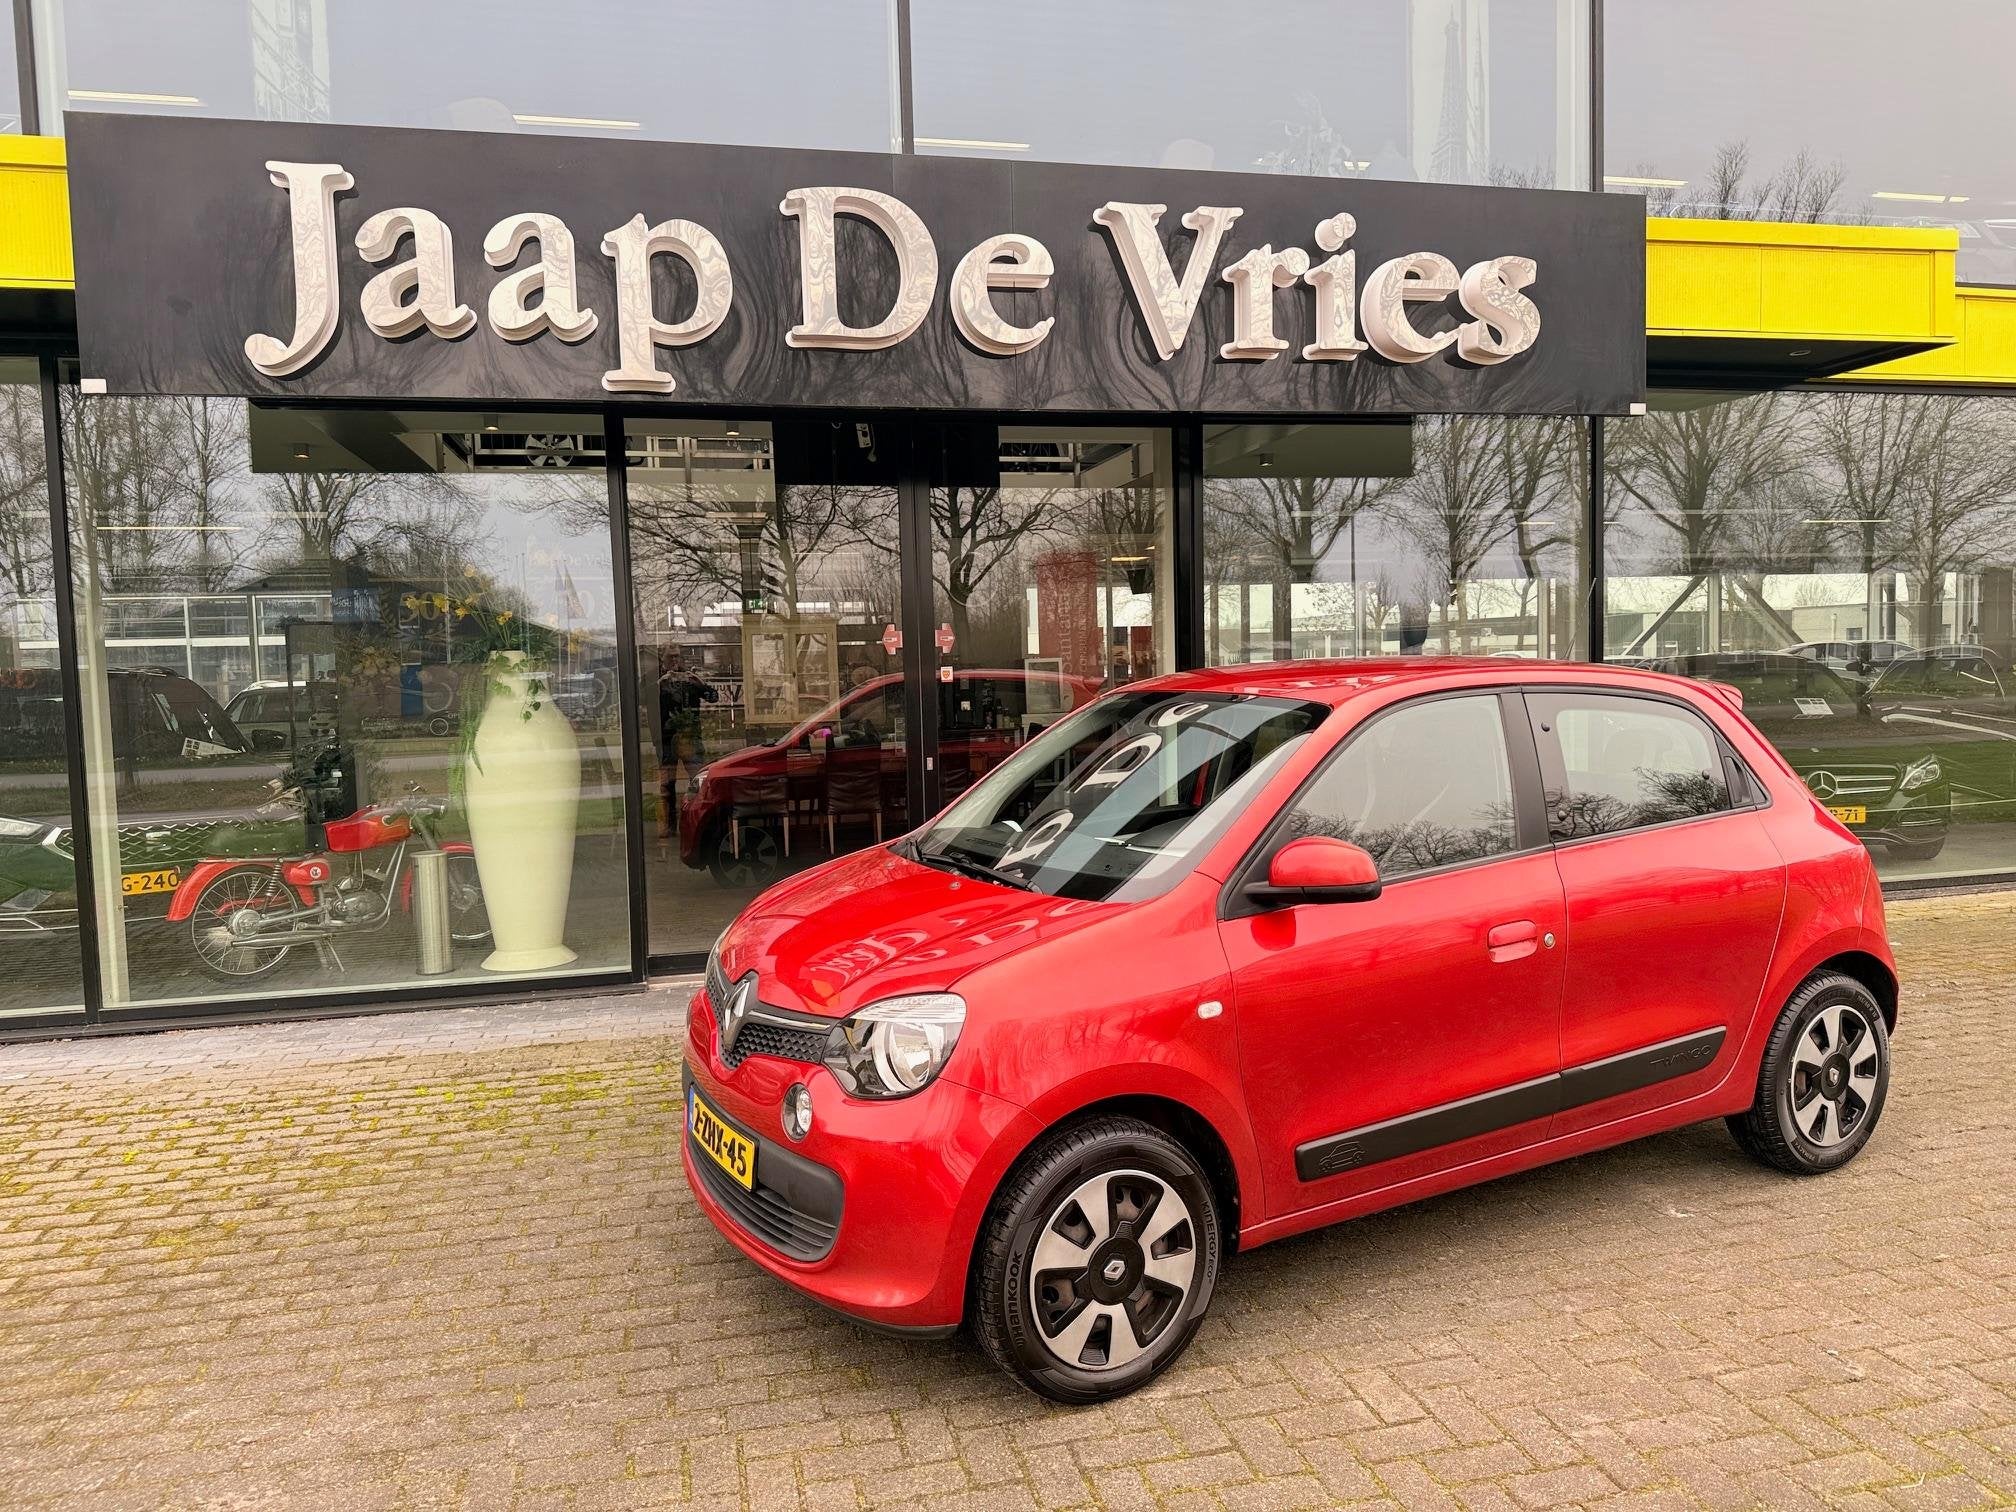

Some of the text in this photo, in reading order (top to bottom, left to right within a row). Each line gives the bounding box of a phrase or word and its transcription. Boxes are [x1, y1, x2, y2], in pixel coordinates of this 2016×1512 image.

[244, 160, 1541, 394] Jaap De Vries
